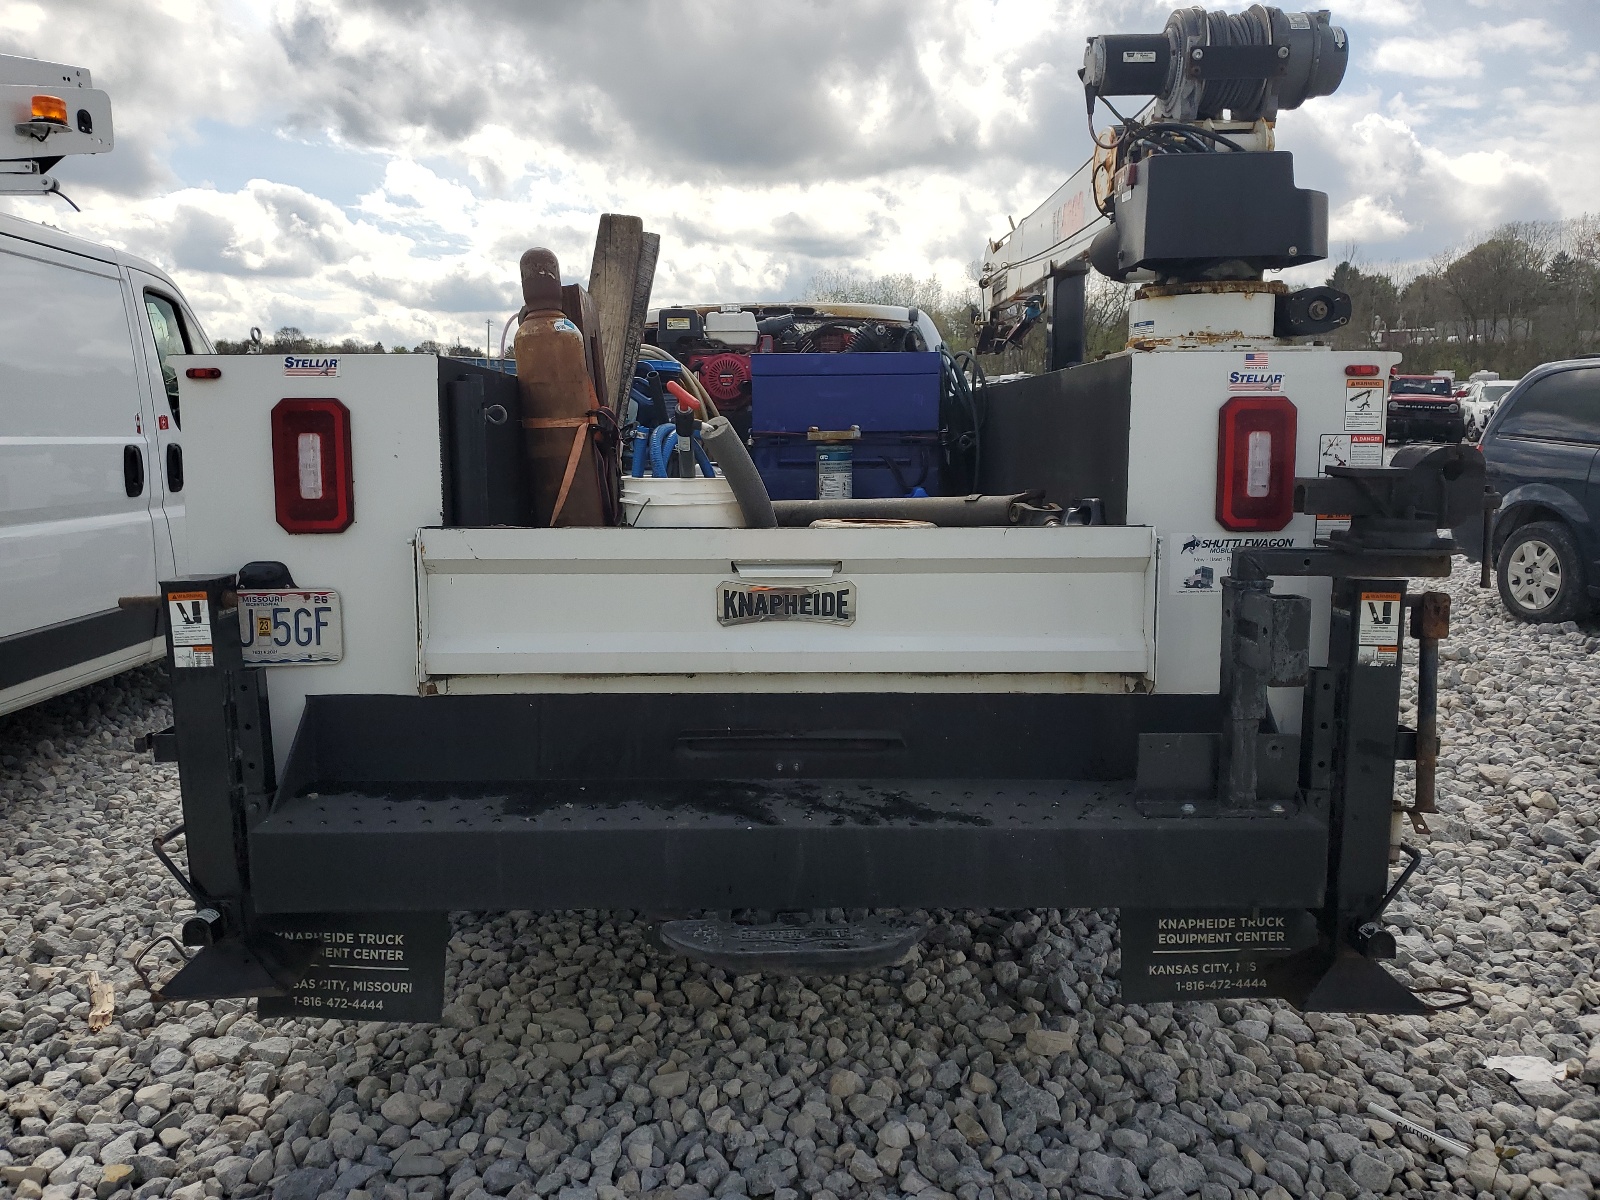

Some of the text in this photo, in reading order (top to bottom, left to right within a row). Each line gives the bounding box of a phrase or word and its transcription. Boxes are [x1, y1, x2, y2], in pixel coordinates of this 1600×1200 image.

[284, 356, 338, 368] STELLAR
[1229, 371, 1282, 383] STELLAR
[1201, 538, 1294, 548] SHUTTLEWAGON
[723, 588, 849, 620] KNAPHEIDE
[259, 621, 269, 631] 23
[1158, 917, 1285, 930] KNAPHEIDE TRUCK
[358, 933, 405, 946] TRUCK
[1158, 931, 1285, 944] EQUIPMENT CENTER
[353, 949, 404, 961] CENTER
[1149, 964, 1199, 975] KANSAS
[1202, 963, 1233, 974] CITY,
[353, 981, 413, 993] MISSOURI
[1176, 979, 1267, 991] 1-816-472-4444
[292, 996, 384, 1010] 1-816-472-4444
[1396, 1121, 1436, 1144] CAUTION
